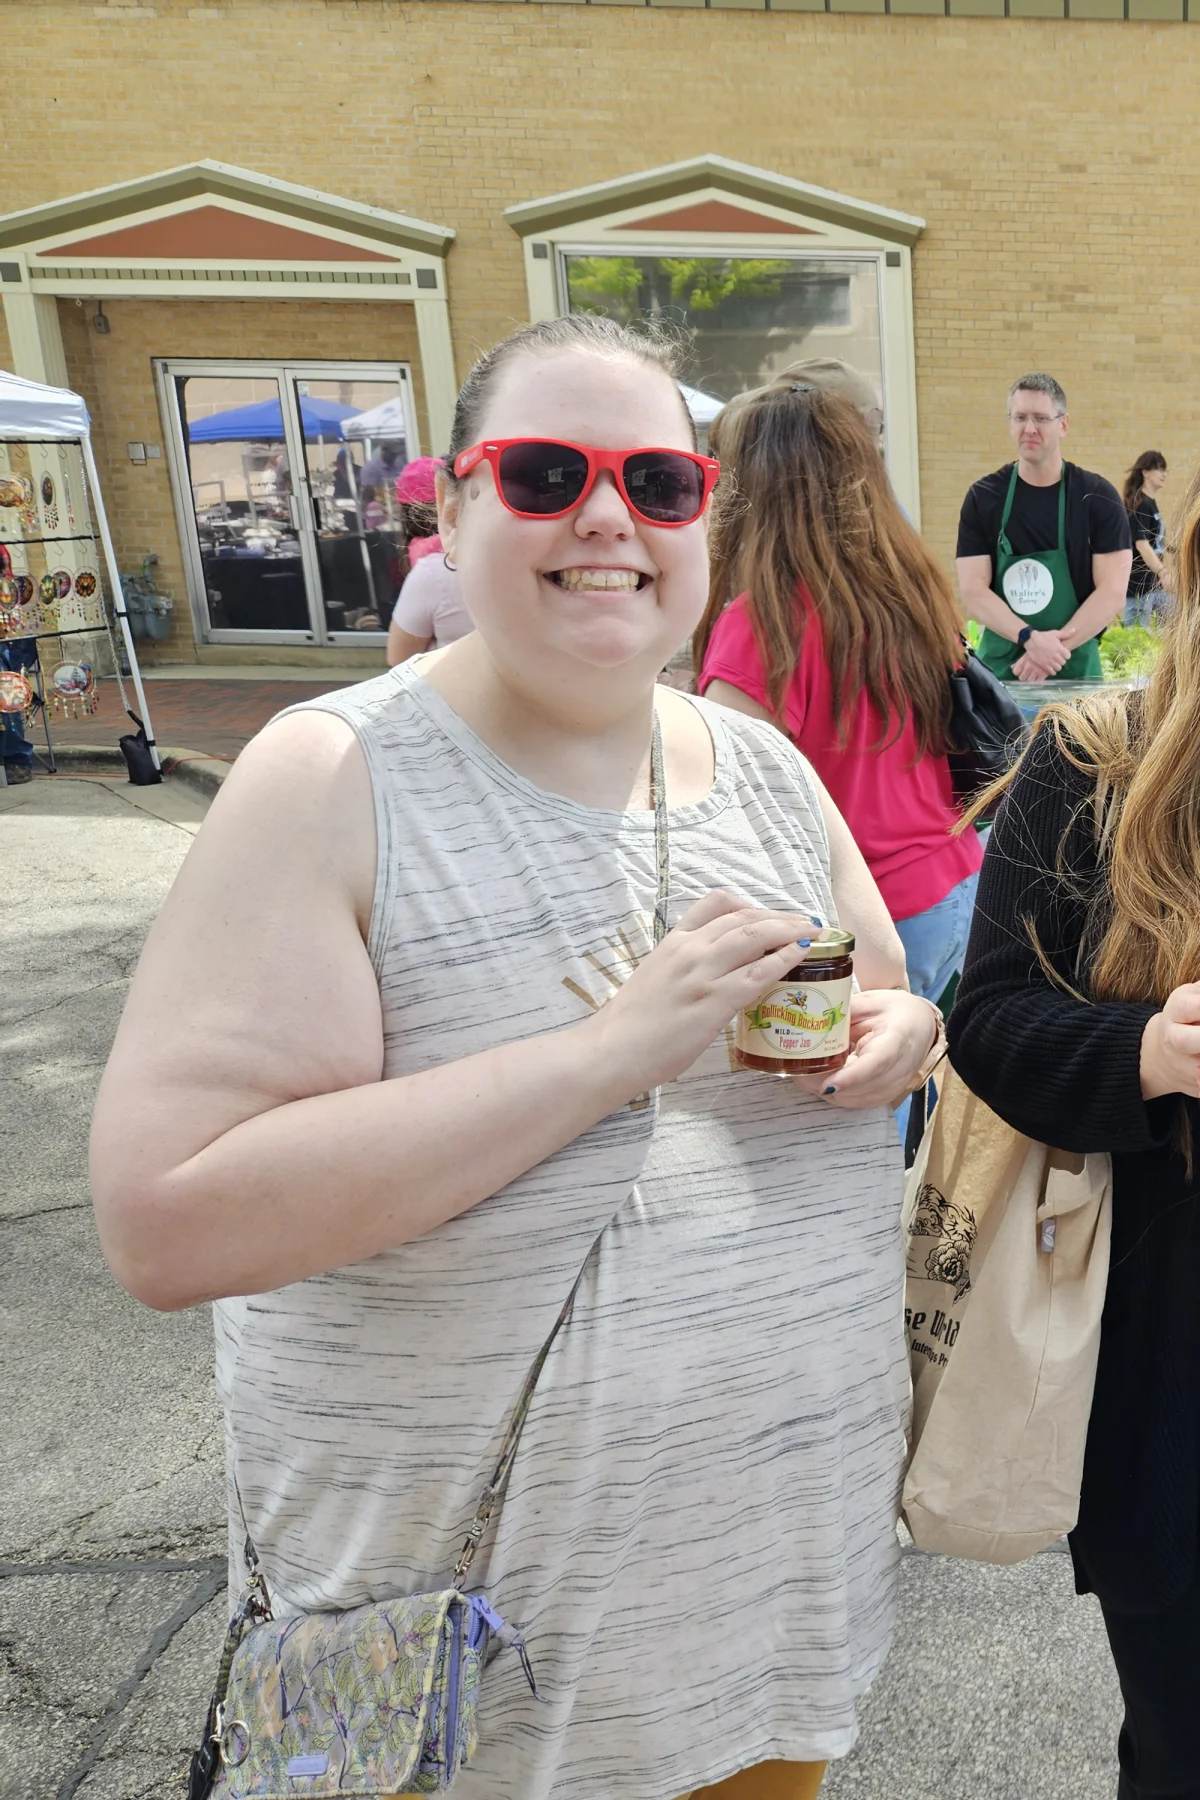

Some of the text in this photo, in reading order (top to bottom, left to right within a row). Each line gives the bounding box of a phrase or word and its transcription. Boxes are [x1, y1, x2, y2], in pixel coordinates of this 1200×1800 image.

[761, 1003, 796, 1026] Rollicking
[779, 1036, 799, 1049] Pepper
[800, 1036, 811, 1048] Jam
